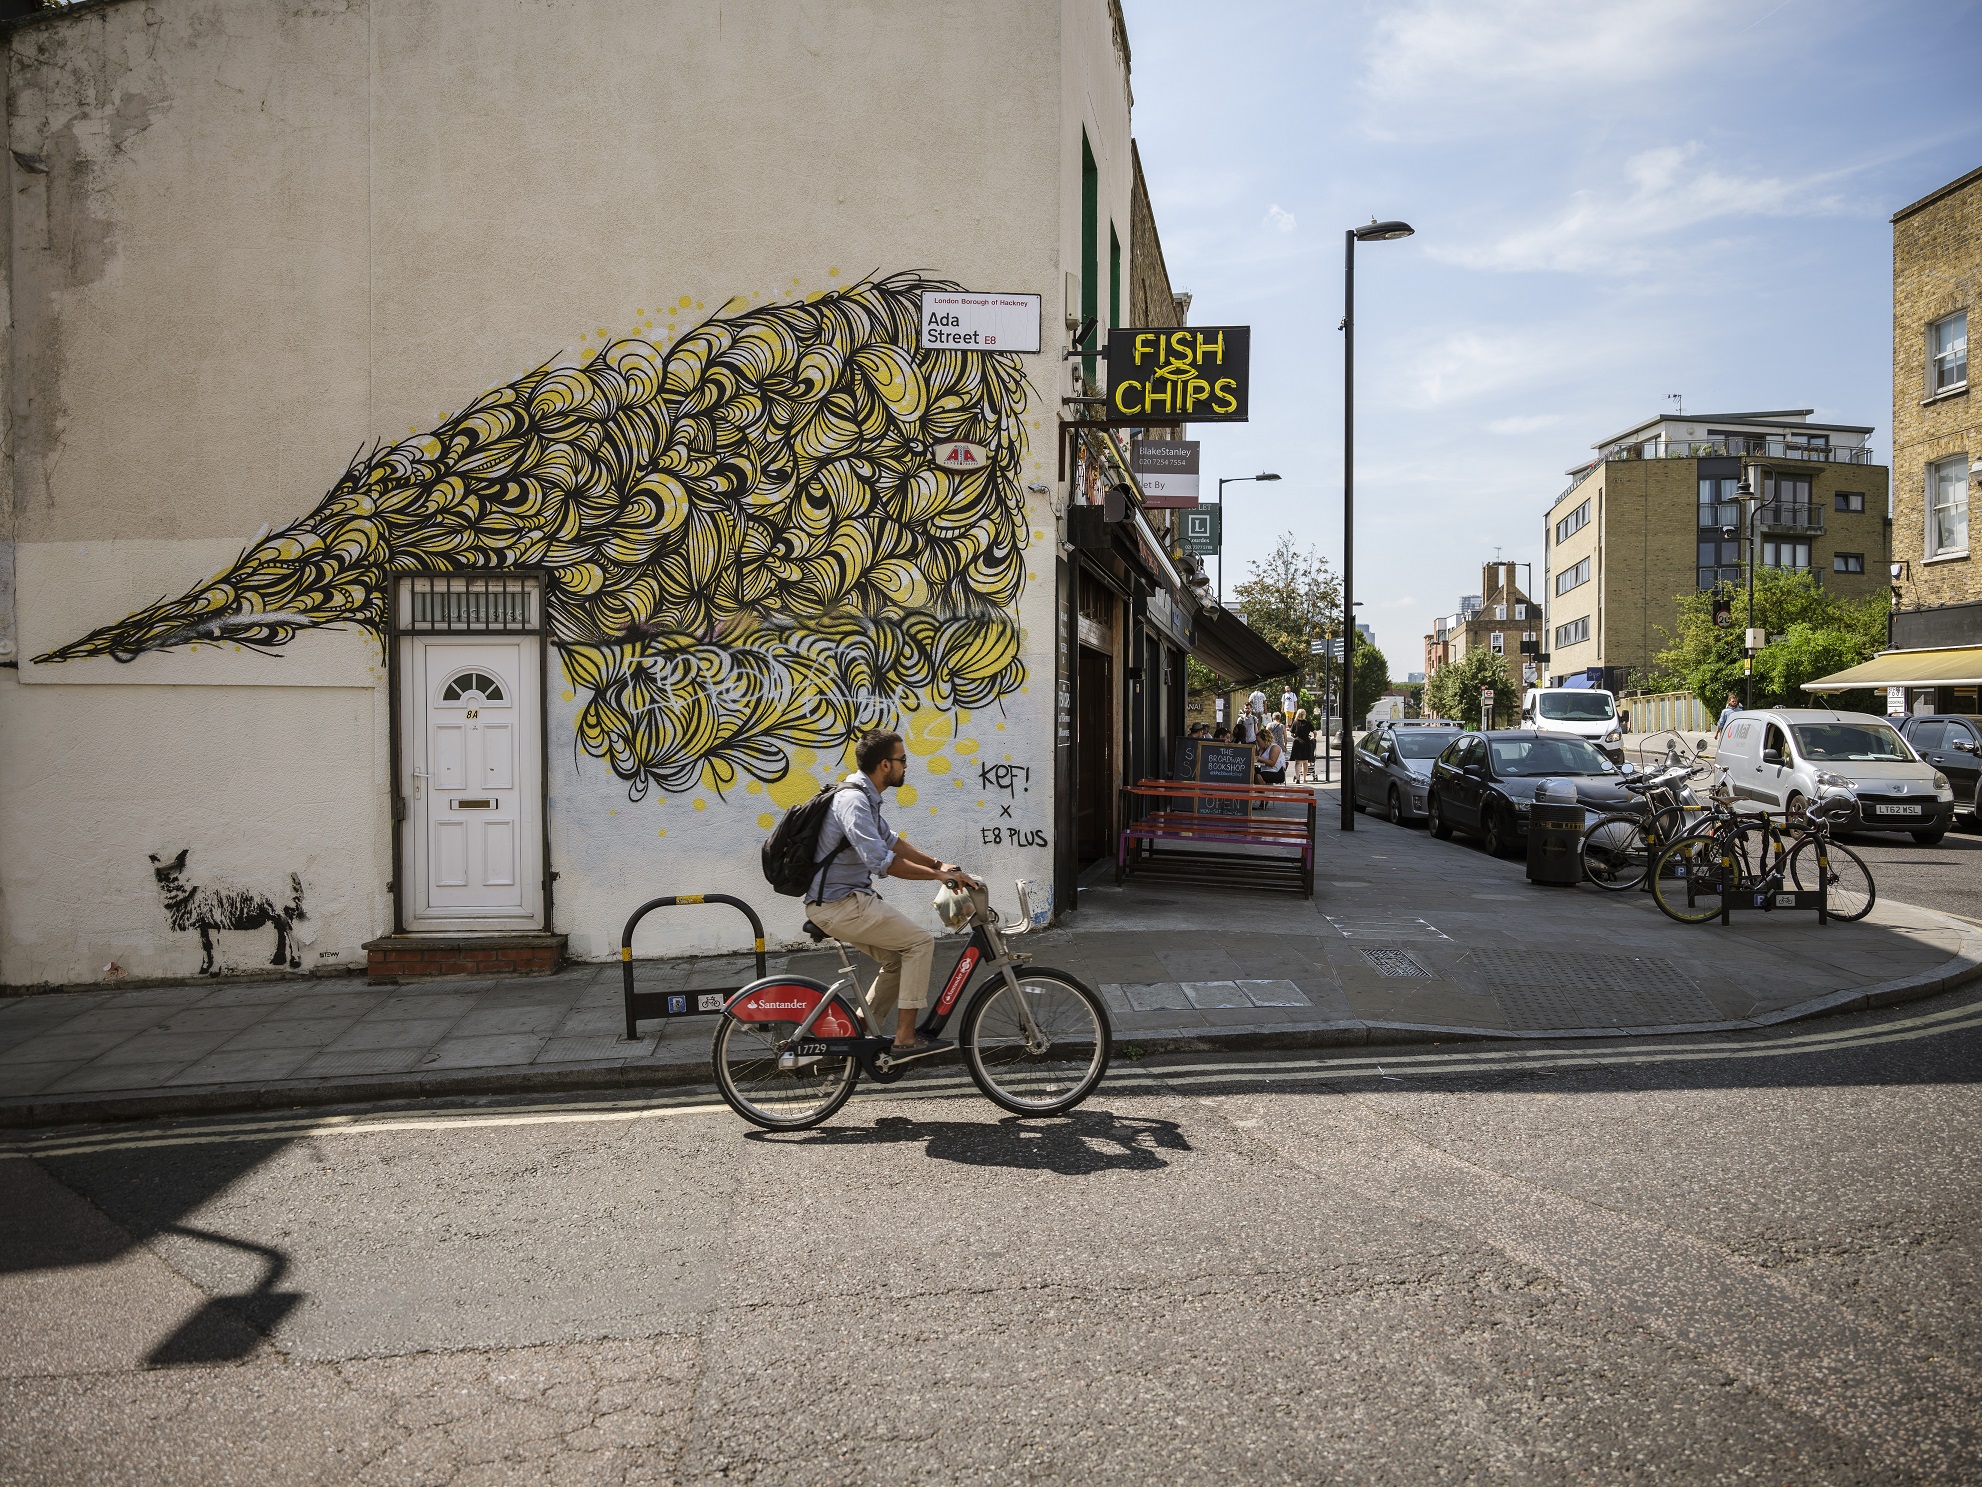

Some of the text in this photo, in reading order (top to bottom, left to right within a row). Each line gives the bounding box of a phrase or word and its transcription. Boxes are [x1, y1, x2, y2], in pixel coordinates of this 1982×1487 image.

[961, 298, 989, 307] Borough
[1000, 300, 1028, 308] Hackney
[927, 312, 960, 327] Ada
[927, 329, 997, 345] Street E8
[1135, 330, 1224, 366] FISH
[1115, 378, 1238, 415] CHIPS
[1139, 446, 1192, 458] BlakeStanley
[1154, 480, 1166, 491] By
[1198, 503, 1212, 511] LET
[1194, 519, 1205, 532] L
[466, 709, 478, 719] 8A
[1220, 748, 1235, 756] THE
[1208, 754, 1246, 764] BROADWAY
[1208, 763, 1246, 772] BOOKSHOP
[1205, 797, 1240, 809] OPEN
[1879, 805, 1901, 814] LT62
[981, 826, 1048, 848] E8 PLUS
[758, 999, 807, 1010] Santander
